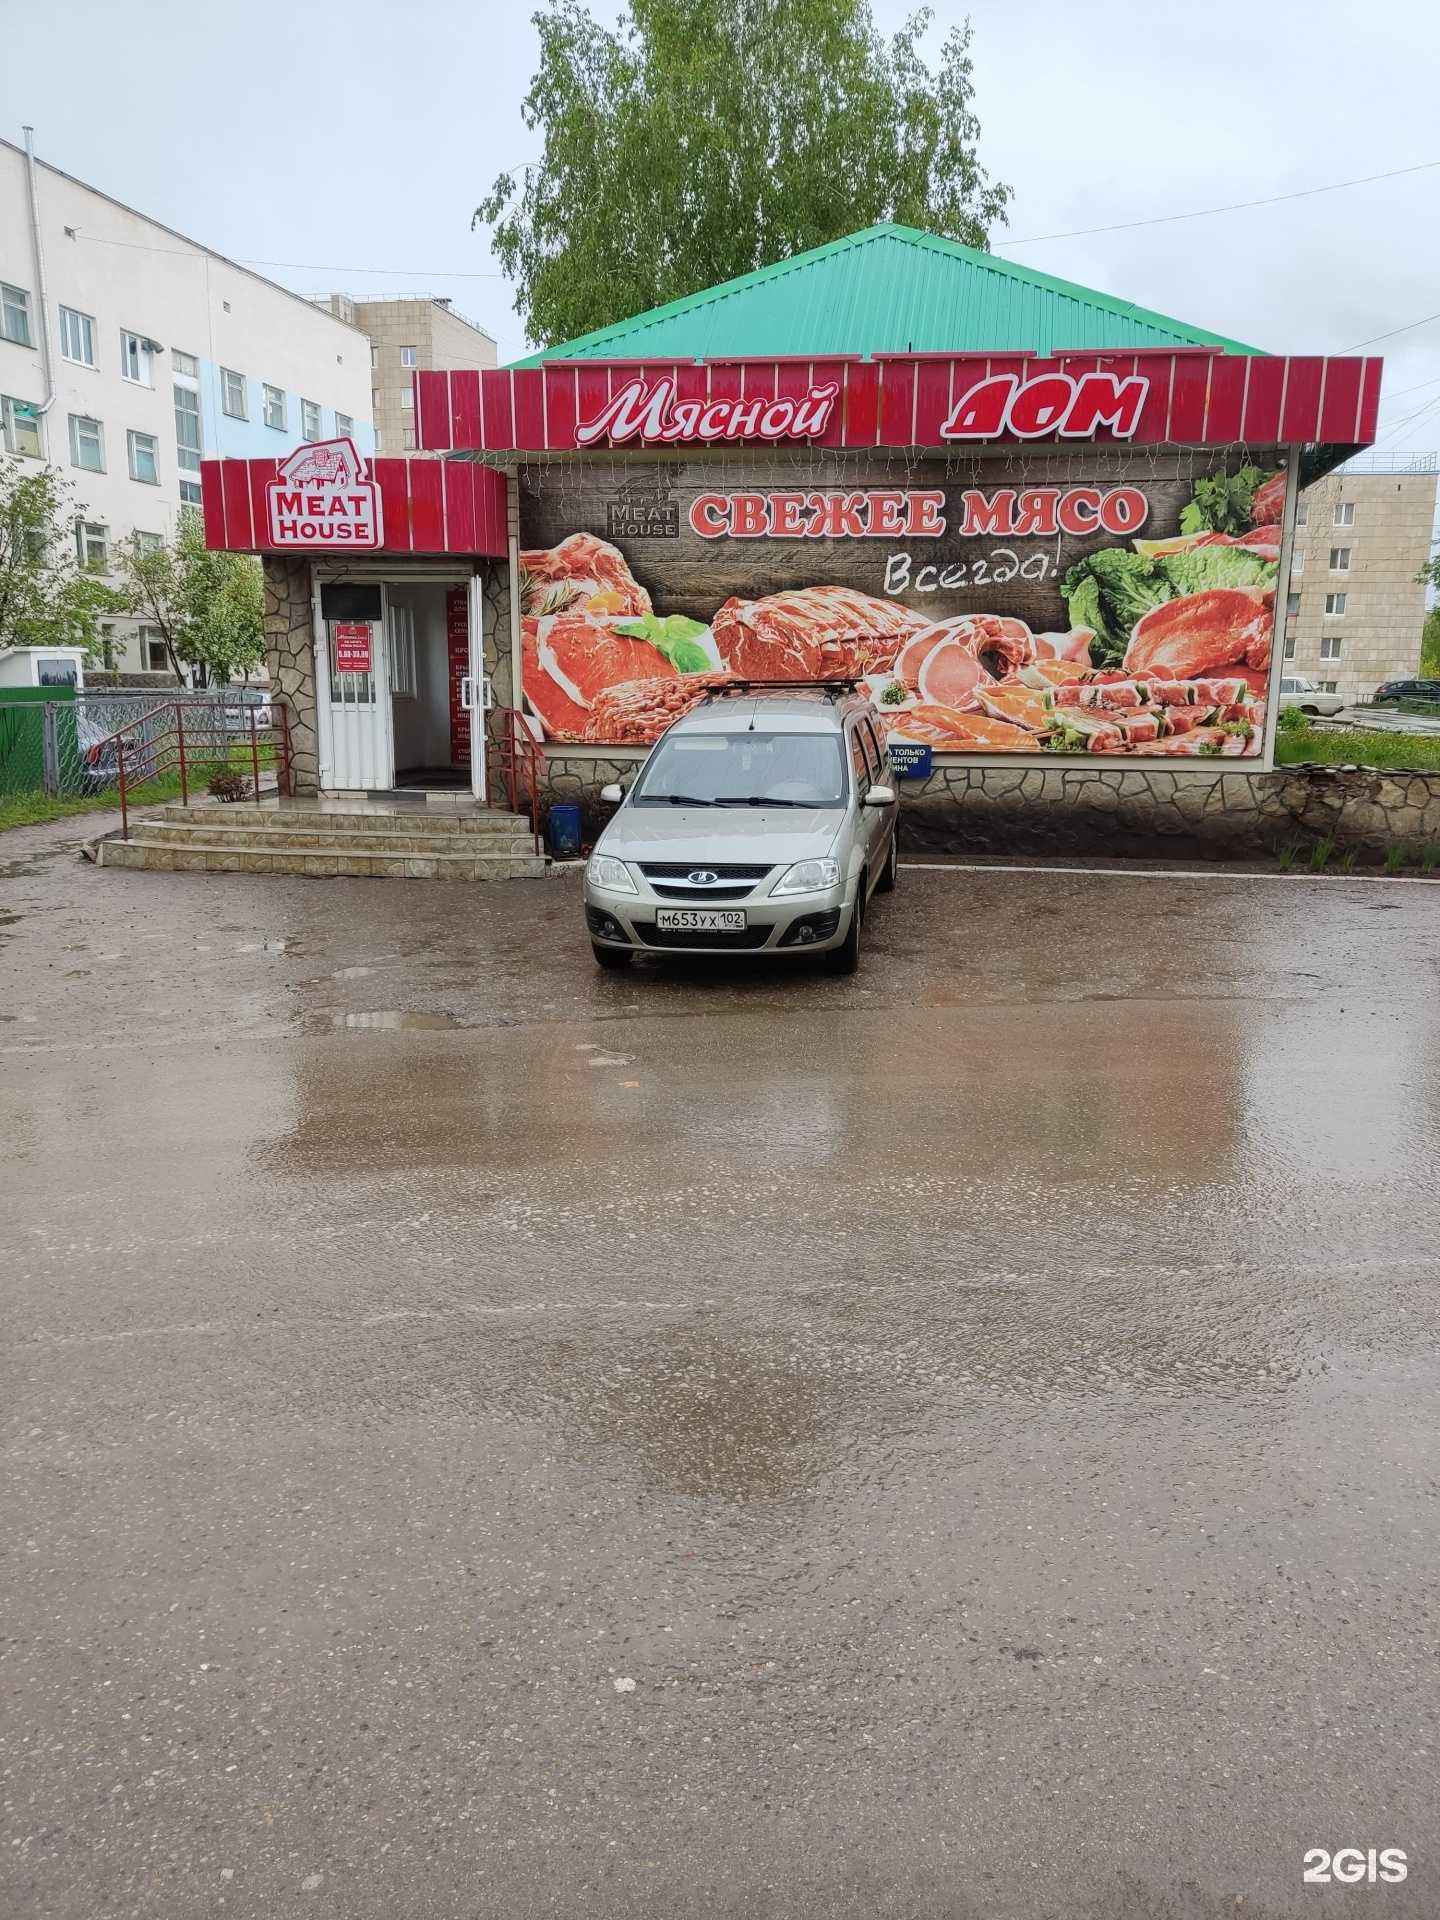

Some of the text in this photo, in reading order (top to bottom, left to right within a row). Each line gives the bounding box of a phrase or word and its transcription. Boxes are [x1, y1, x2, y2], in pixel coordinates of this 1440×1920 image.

[576, 374, 1149, 443] Мясной ДОМ
[276, 492, 367, 516] MEAT
[611, 504, 675, 521] MEAT
[690, 488, 1148, 538] СВЕЖЕЕ МЯСО
[279, 519, 369, 539] HOUSE
[612, 522, 675, 535] HOUSE
[883, 533, 1061, 595] Всегда!
[891, 756, 918, 764] ЕНТОВ
[720, 913, 741, 924] 102
